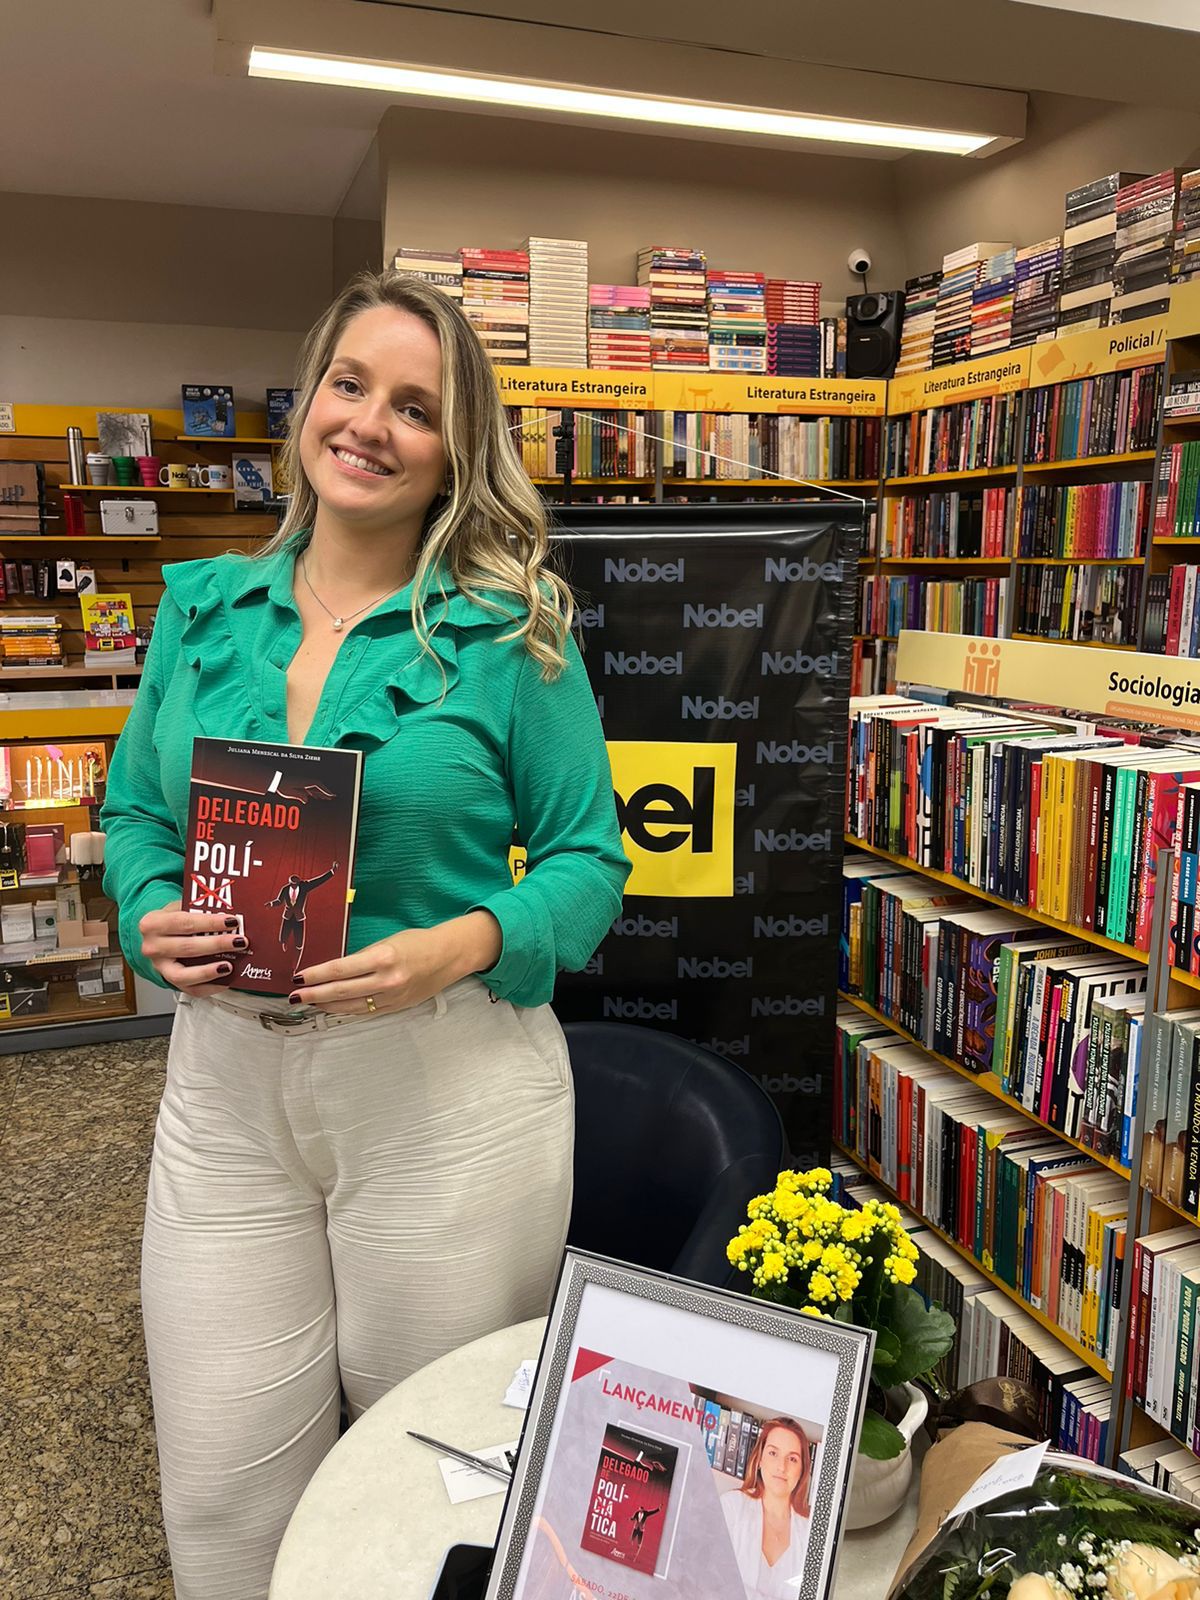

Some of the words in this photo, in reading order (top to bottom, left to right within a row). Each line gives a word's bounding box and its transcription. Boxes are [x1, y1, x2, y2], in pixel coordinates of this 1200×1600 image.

[1109, 332, 1154, 355] Policial
[500, 378, 567, 392] Literatura
[571, 380, 647, 398] Estrangeira
[924, 377, 965, 394] Literatura
[967, 362, 1021, 385] Estrangeira
[747, 386, 806, 401] Literatura
[809, 388, 876, 404] Estrangeira
[604, 558, 684, 583] Nobel
[765, 557, 844, 582] Nobel
[683, 603, 764, 628] Nobel
[604, 651, 683, 675] Nobel
[761, 651, 838, 676] Nobel
[1108, 671, 1200, 707] Sociologia
[682, 695, 759, 720] Nobel
[756, 740, 834, 764] Nobel
[1105, 774, 1113, 792] JESSÉ
[197, 796, 301, 830] DELEGADO
[196, 822, 215, 841] DE
[754, 828, 831, 853] Nobel
[1102, 821, 1110, 842] CLASSE
[193, 840, 263, 878] POLÍ-
[1101, 842, 1109, 861] MÉDIA
[753, 914, 829, 938] Nobel
[1034, 949, 1057, 960] JOHN
[677, 957, 753, 979] Nobel
[603, 996, 678, 1021] Nobel
[751, 995, 825, 1017] Nobel
[935, 976, 946, 1032] CORRUPTÍVEIS
[945, 982, 956, 1038] CORRUPTÍVEIS
[957, 990, 965, 1026] CONSCIÊNCIA
[956, 1026, 965, 1055] FEMINISTA
[1030, 1022, 1040, 1051] DÉCADA
[1091, 1016, 1099, 1043] INJUSTIÇA
[1025, 1052, 1036, 1087] ROUBADA
[1088, 1048, 1097, 1075] VIOLÊNCIA
[1100, 1054, 1109, 1081] VIOLÊNCIA
[1189, 1145, 1198, 1181] VENDA
[1182, 1285, 1193, 1307] POVO,
[1180, 1309, 1190, 1334] PODER
[1179, 1339, 1188, 1365] LUCRO
[1177, 1370, 1185, 1392] JOSEPH
[602, 1379, 717, 1431] LANÇAMENTO
[1175, 1397, 1183, 1421] STIGLITZ
[600, 1469, 610, 1480] DE
[602, 1455, 650, 1484] DELEGADO
[597, 1479, 629, 1504] POLÍ-
[590, 1513, 617, 1538] TICA
